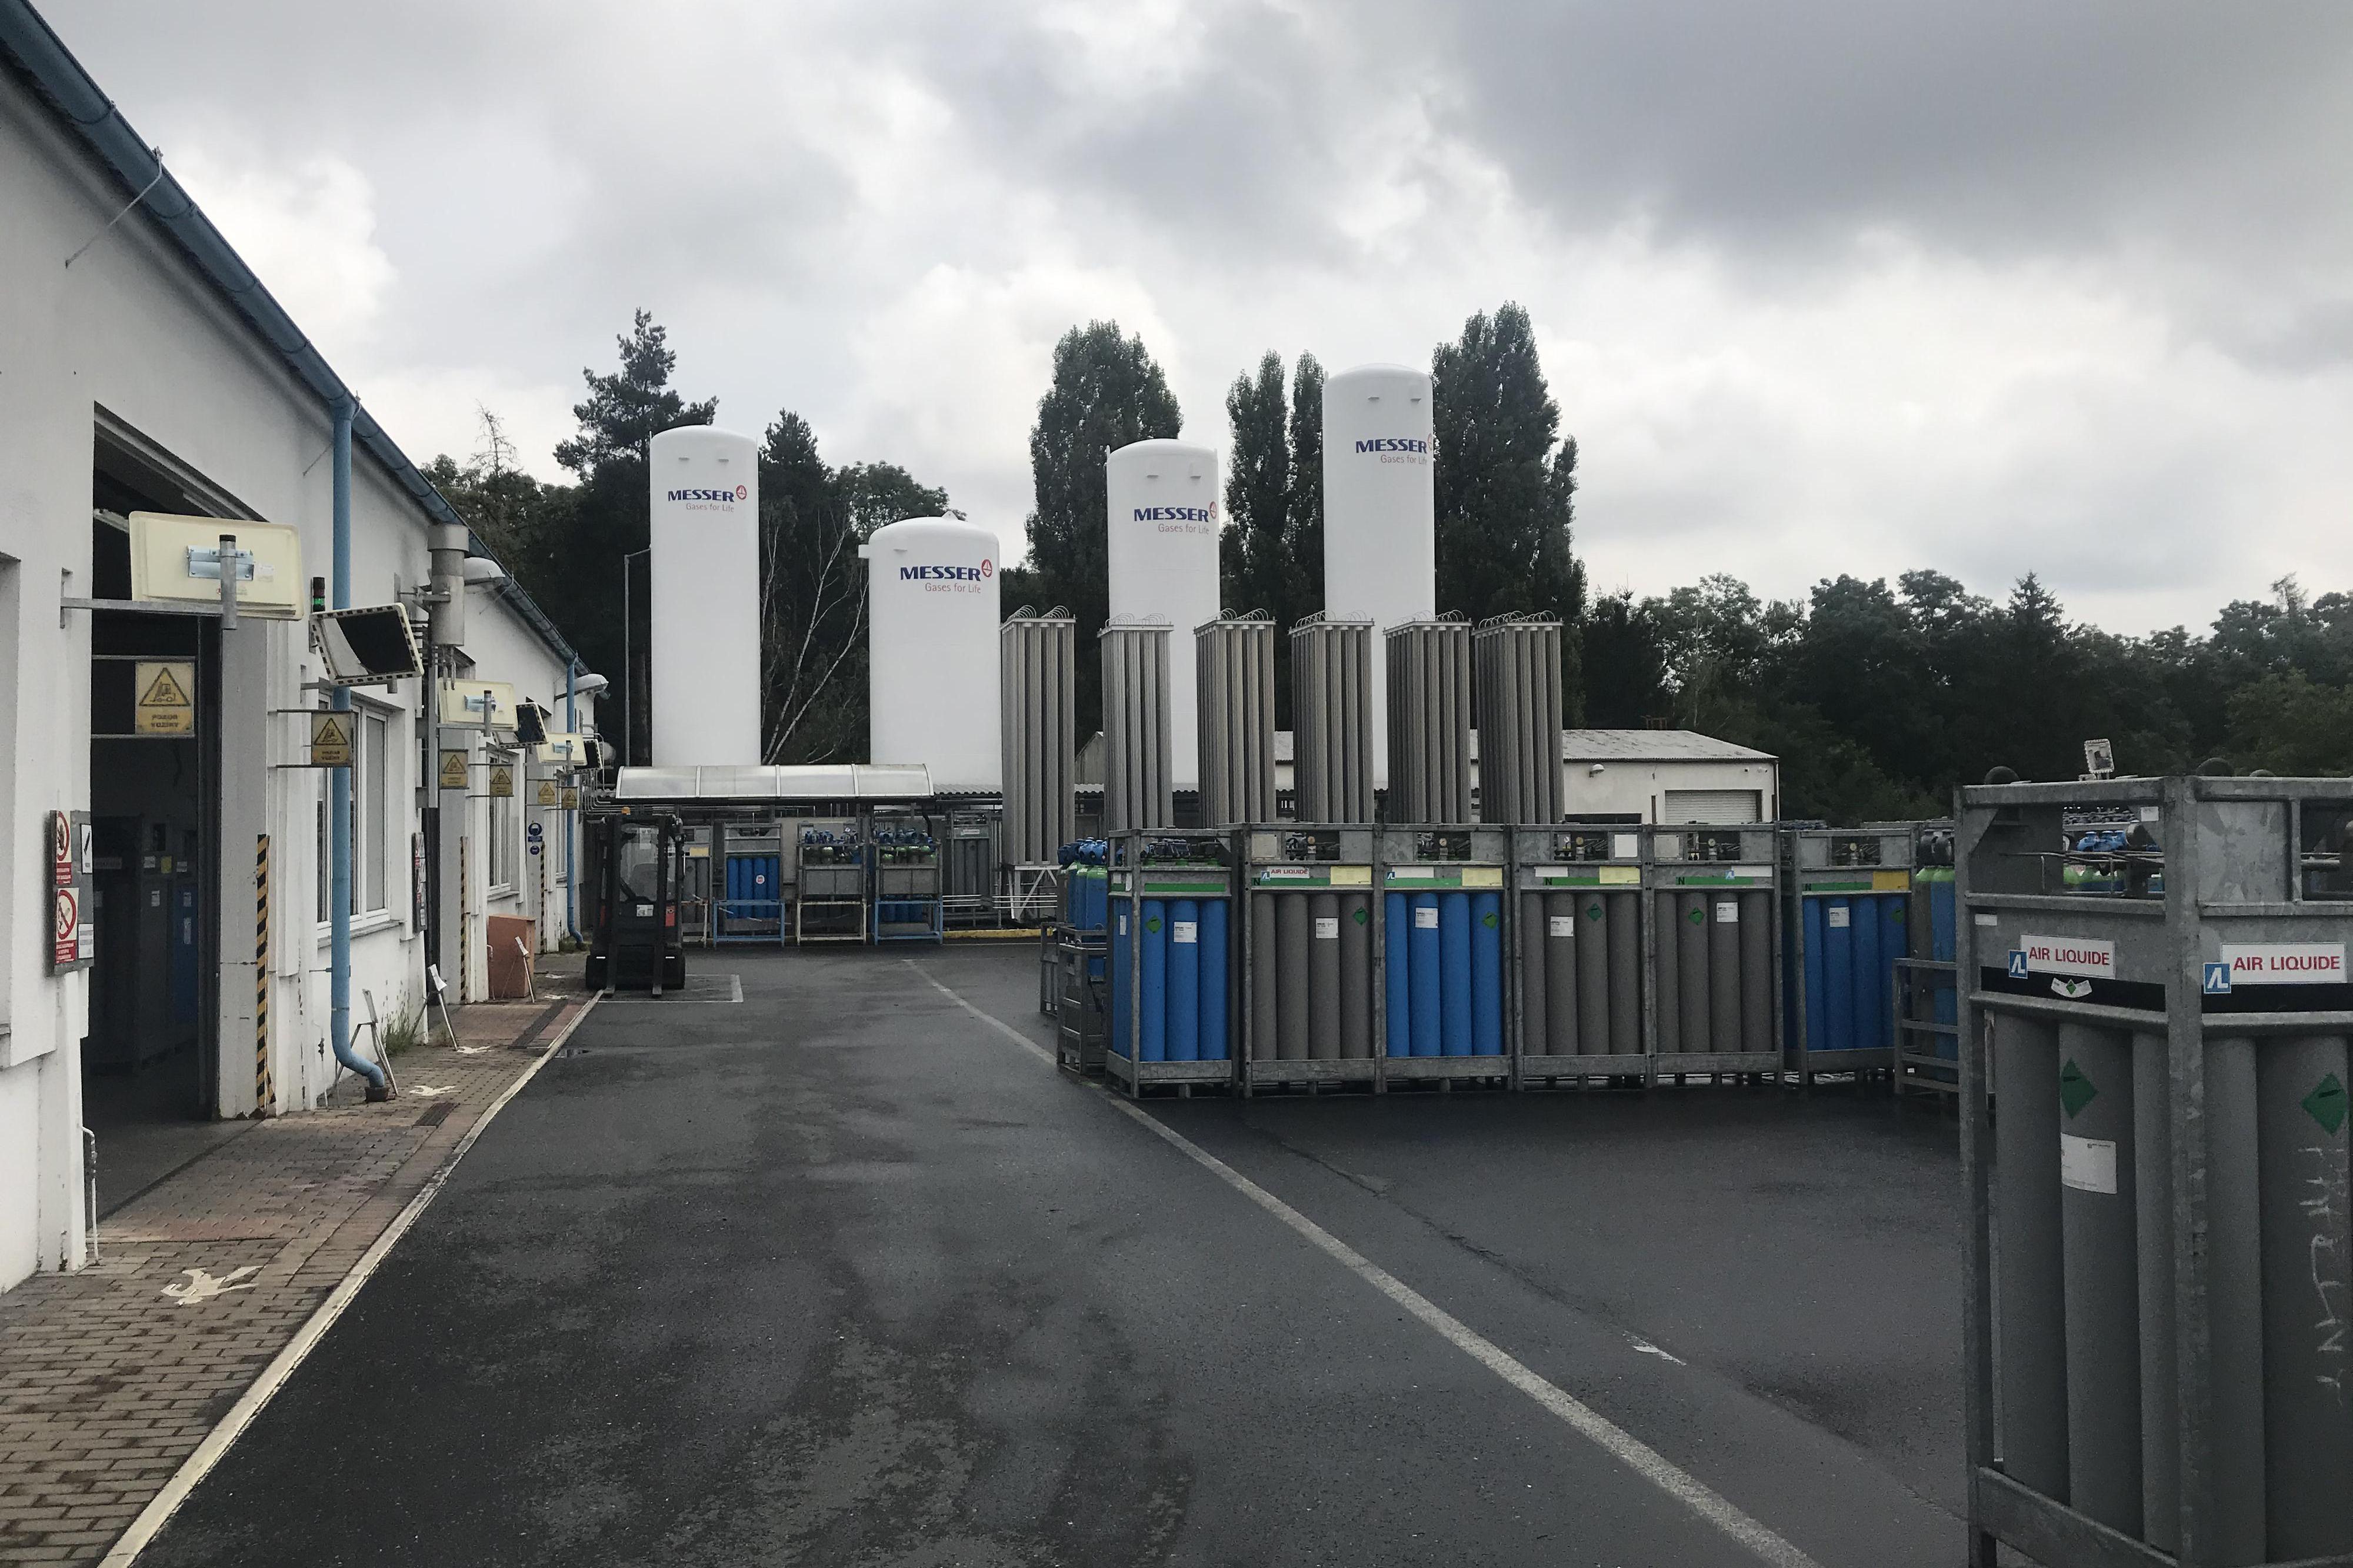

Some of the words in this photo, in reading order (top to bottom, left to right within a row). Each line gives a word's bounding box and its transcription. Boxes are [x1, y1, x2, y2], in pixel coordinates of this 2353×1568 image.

[1355, 438, 1427, 454] MESSER
[1380, 454, 1404, 463] Gases
[1407, 454, 1417, 463] for
[668, 489, 734, 502] MESSER
[722, 504, 734, 513] Life
[1134, 507, 1209, 522] MESSER
[1158, 523, 1183, 532] Gases
[1186, 523, 1196, 533] for
[1199, 525, 1209, 535] Life
[900, 566, 981, 582] MESSER
[925, 582, 951, 592] Gases
[954, 583, 966, 592] for
[968, 584, 981, 593] Life
[2029, 946, 2050, 960] AIR
[2055, 948, 2110, 965] LIQUIDE
[2234, 956, 2263, 970] AIR
[2271, 956, 2340, 970] LIQUIDE
